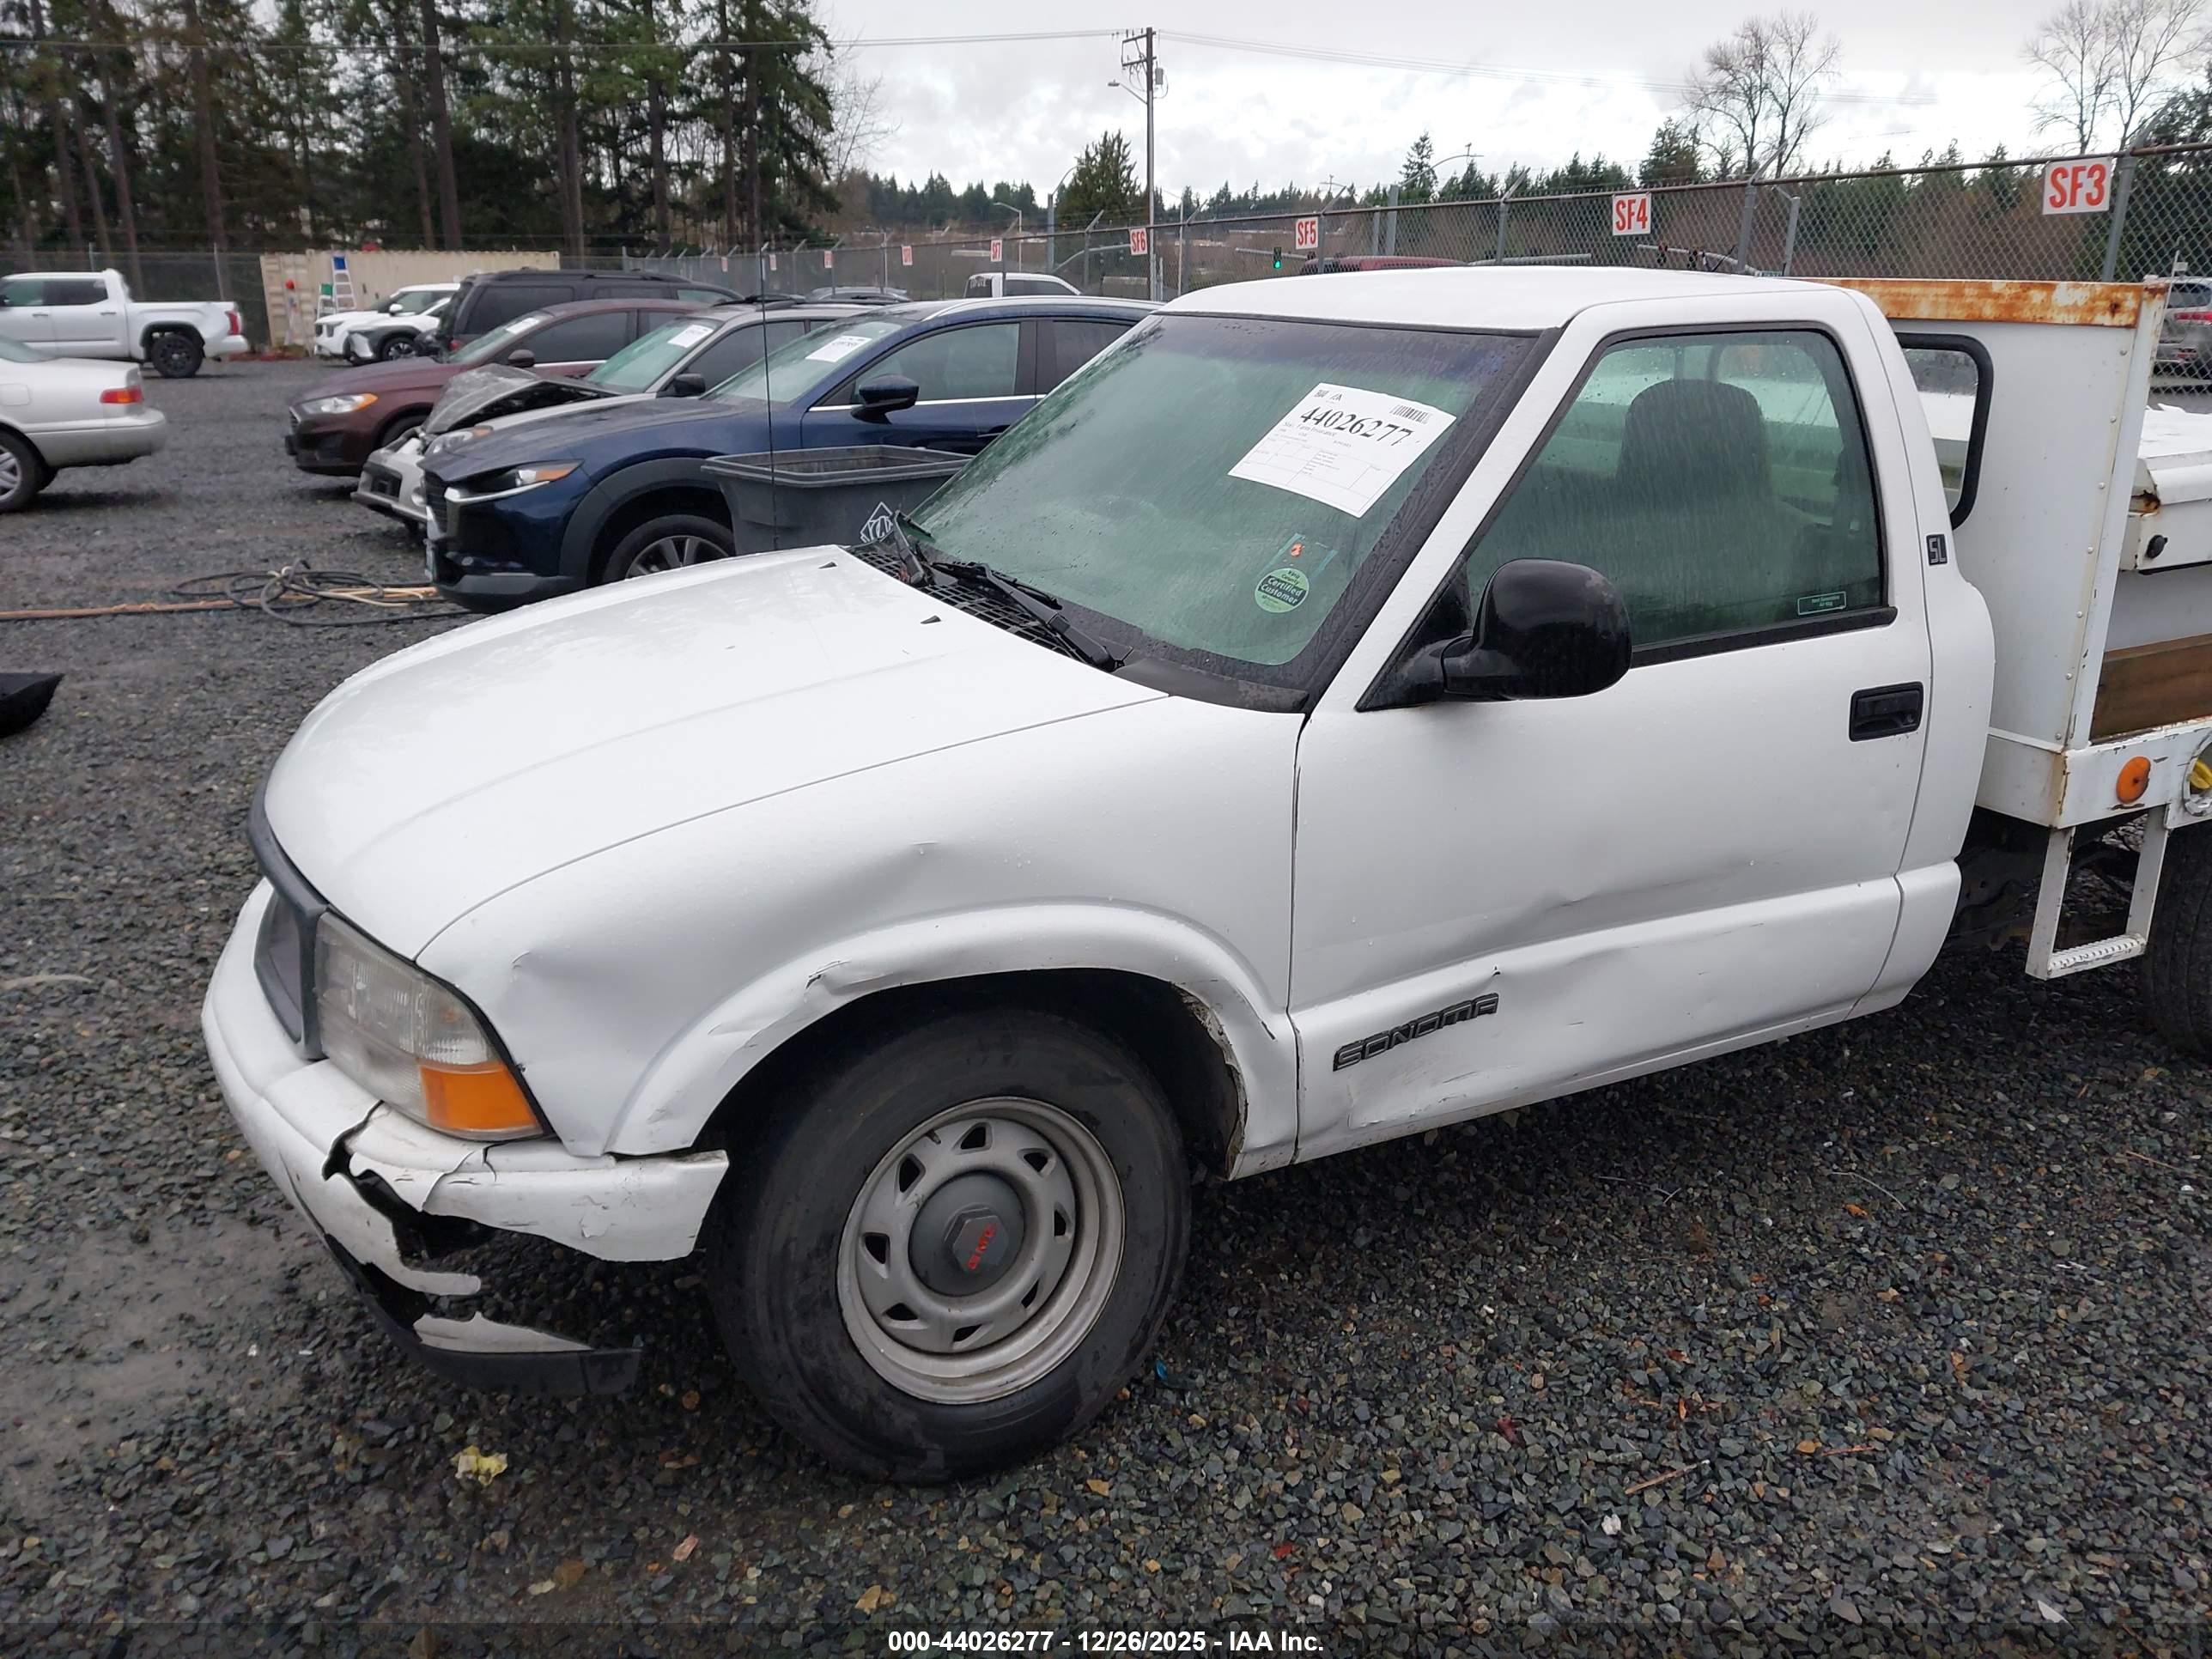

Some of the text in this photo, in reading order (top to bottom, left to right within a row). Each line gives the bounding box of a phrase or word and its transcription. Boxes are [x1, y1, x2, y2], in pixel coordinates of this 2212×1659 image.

[2049, 163, 2106, 209] SF3
[1615, 198, 1648, 231] SF4
[1131, 230, 1146, 252] SF6
[1297, 220, 1316, 246] SF5
[1300, 406, 1415, 447] 44026277
[1261, 584, 1298, 605] Customer
[1267, 577, 1303, 597] Certified
[1332, 993, 1499, 1072] SONOMA
